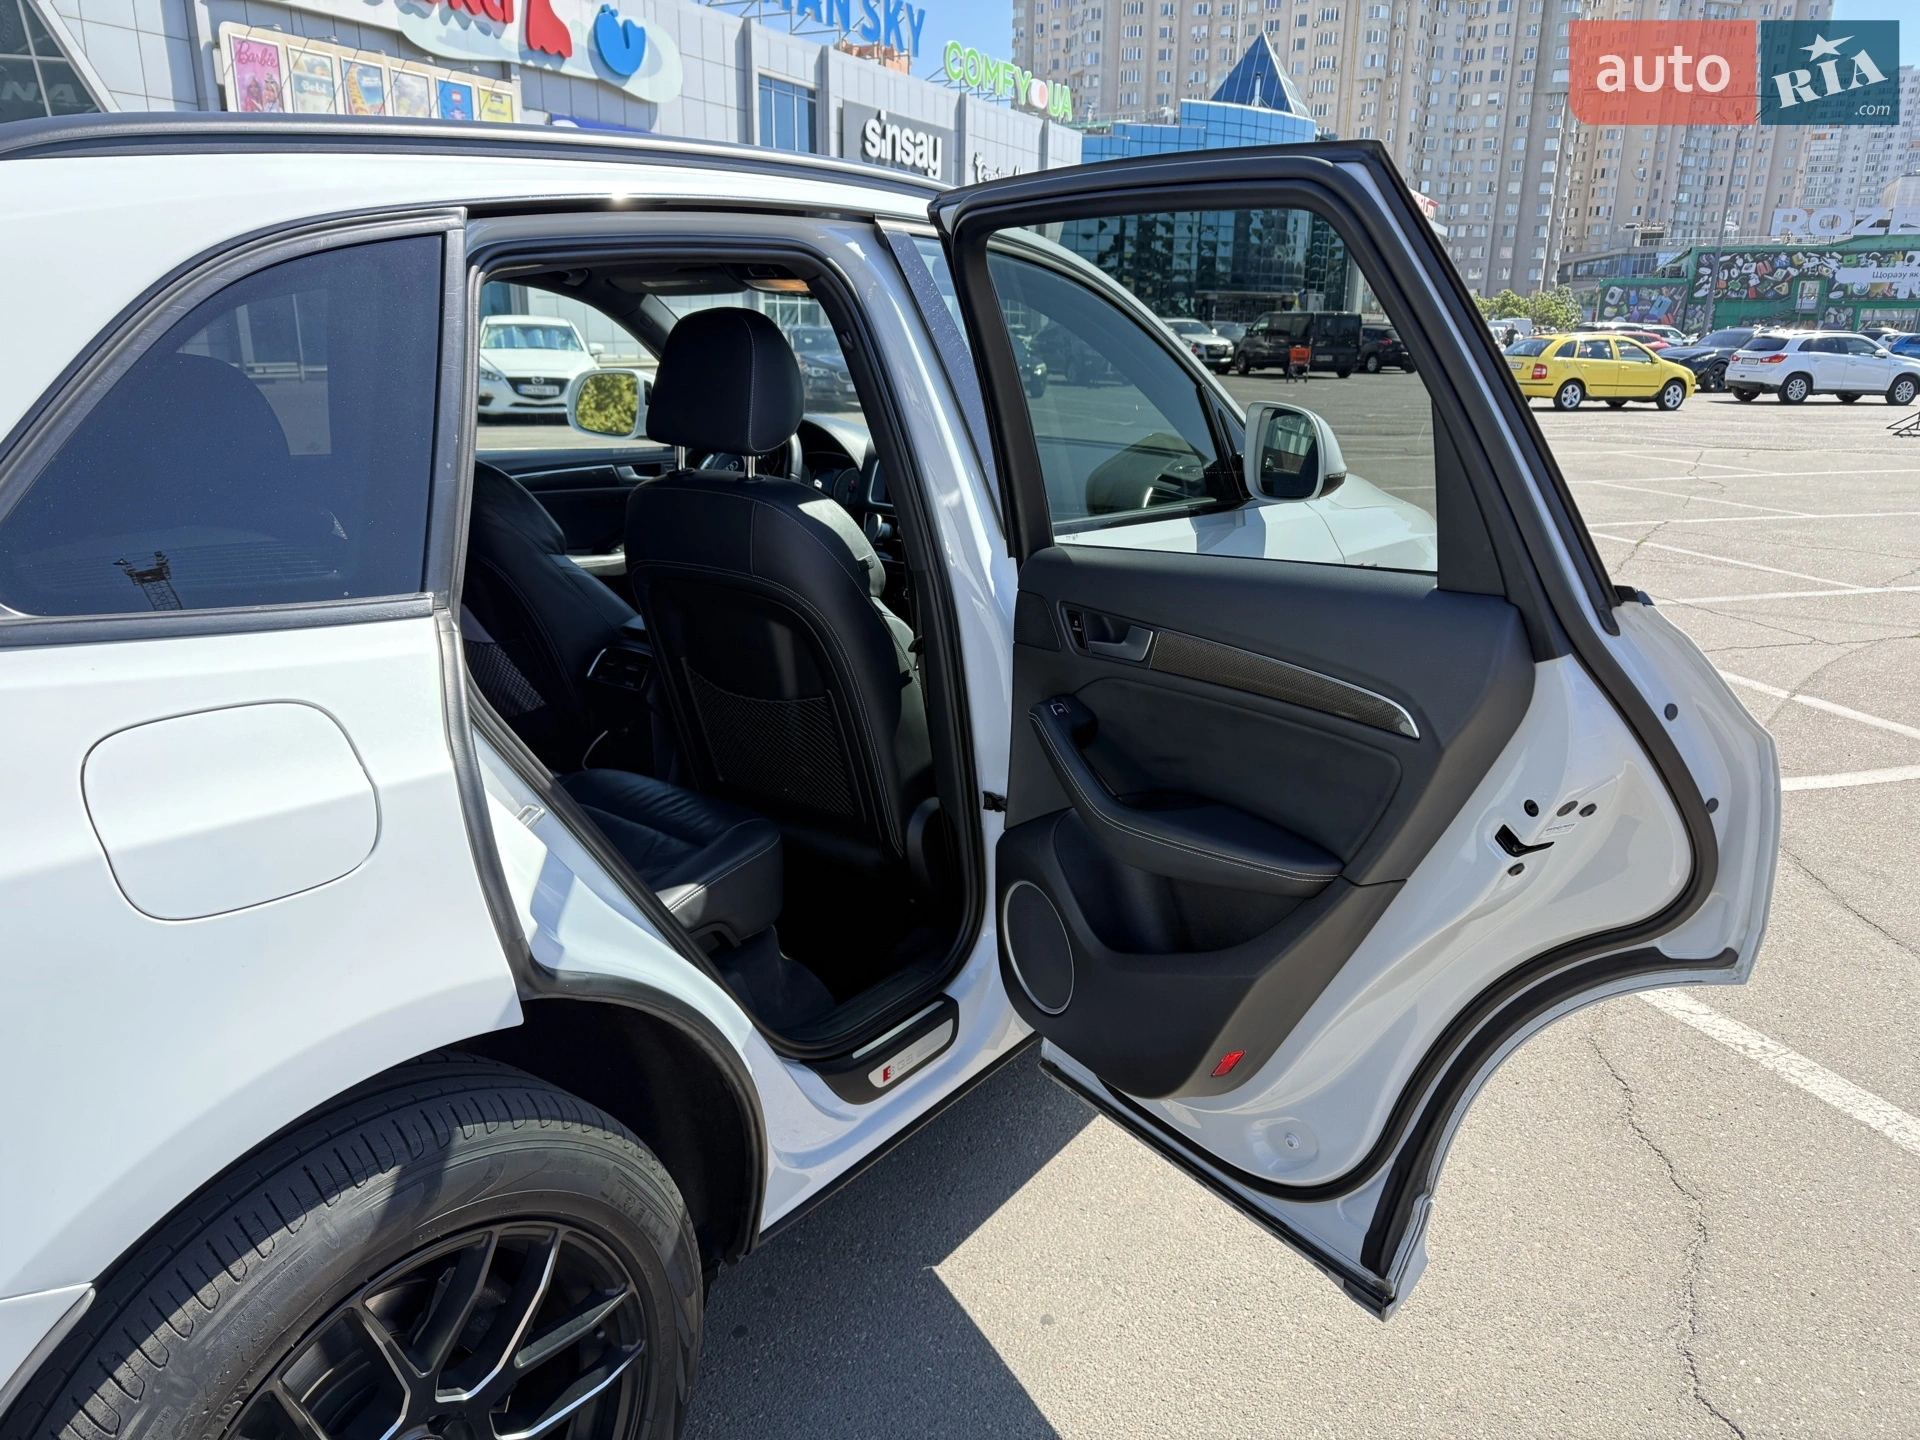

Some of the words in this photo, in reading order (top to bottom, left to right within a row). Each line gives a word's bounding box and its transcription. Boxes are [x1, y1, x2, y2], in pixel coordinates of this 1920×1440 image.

[235, 41, 278, 68] Barbie
[859, 0, 926, 57] SKY
[944, 40, 1032, 105] COMFY
[1048, 80, 1073, 121] UA
[865, 110, 942, 180] sinsay
[1872, 271, 1908, 279] Щоразу
